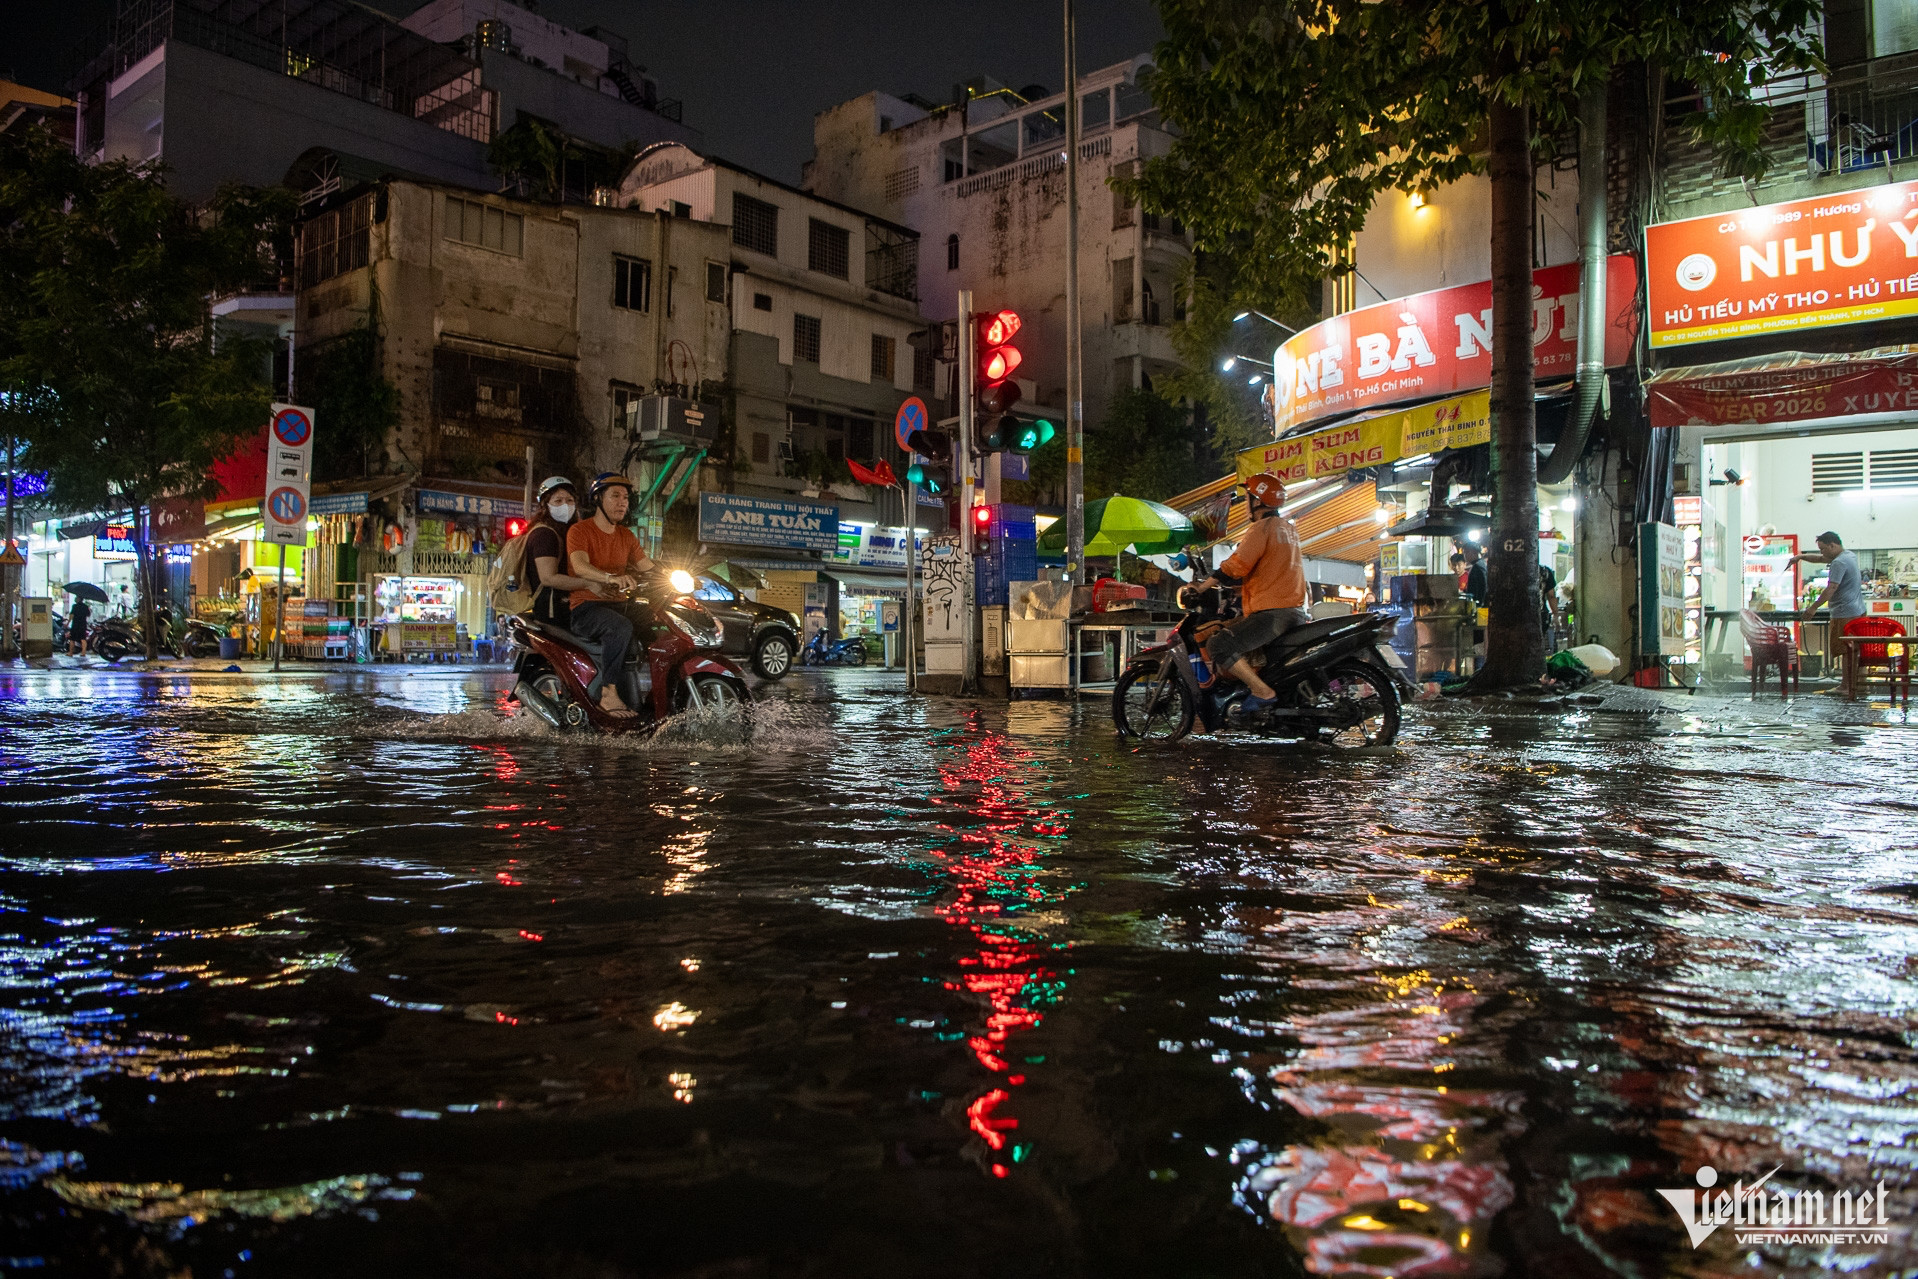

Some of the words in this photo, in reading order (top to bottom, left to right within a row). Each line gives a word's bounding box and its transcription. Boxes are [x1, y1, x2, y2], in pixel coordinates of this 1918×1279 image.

[1718, 220, 1737, 234] Cô
[1813, 202, 1862, 219] Hương
[1739, 217, 1877, 283] NHƯ
[1665, 303, 1693, 325] HỦ
[1697, 297, 1742, 320] TIẾU
[1748, 292, 1780, 313] MỸ
[1783, 288, 1829, 309] THO
[1848, 278, 1881, 300] HỦ
[1864, 307, 1885, 315] HCM
[1356, 311, 1436, 380] BÀ
[1381, 379, 1398, 392] Chí
[1399, 375, 1424, 390] Minh
[1713, 402, 1767, 420] YEAR
[1773, 396, 1827, 416] 2026
[1264, 441, 1303, 464] DIM
[1311, 427, 1360, 452] SUM
[1314, 445, 1383, 474] KÔNG
[708, 493, 727, 505] CỬA
[729, 496, 753, 508] HÀNG
[755, 501, 782, 511] TRANG
[798, 504, 813, 514] NỘI
[814, 505, 834, 516] THẤT
[720, 509, 766, 527] ANH
[768, 512, 822, 531] TUẤN
[868, 535, 896, 548] MINH
[1503, 538, 1525, 552] 62
[879, 588, 901, 597] MINH
